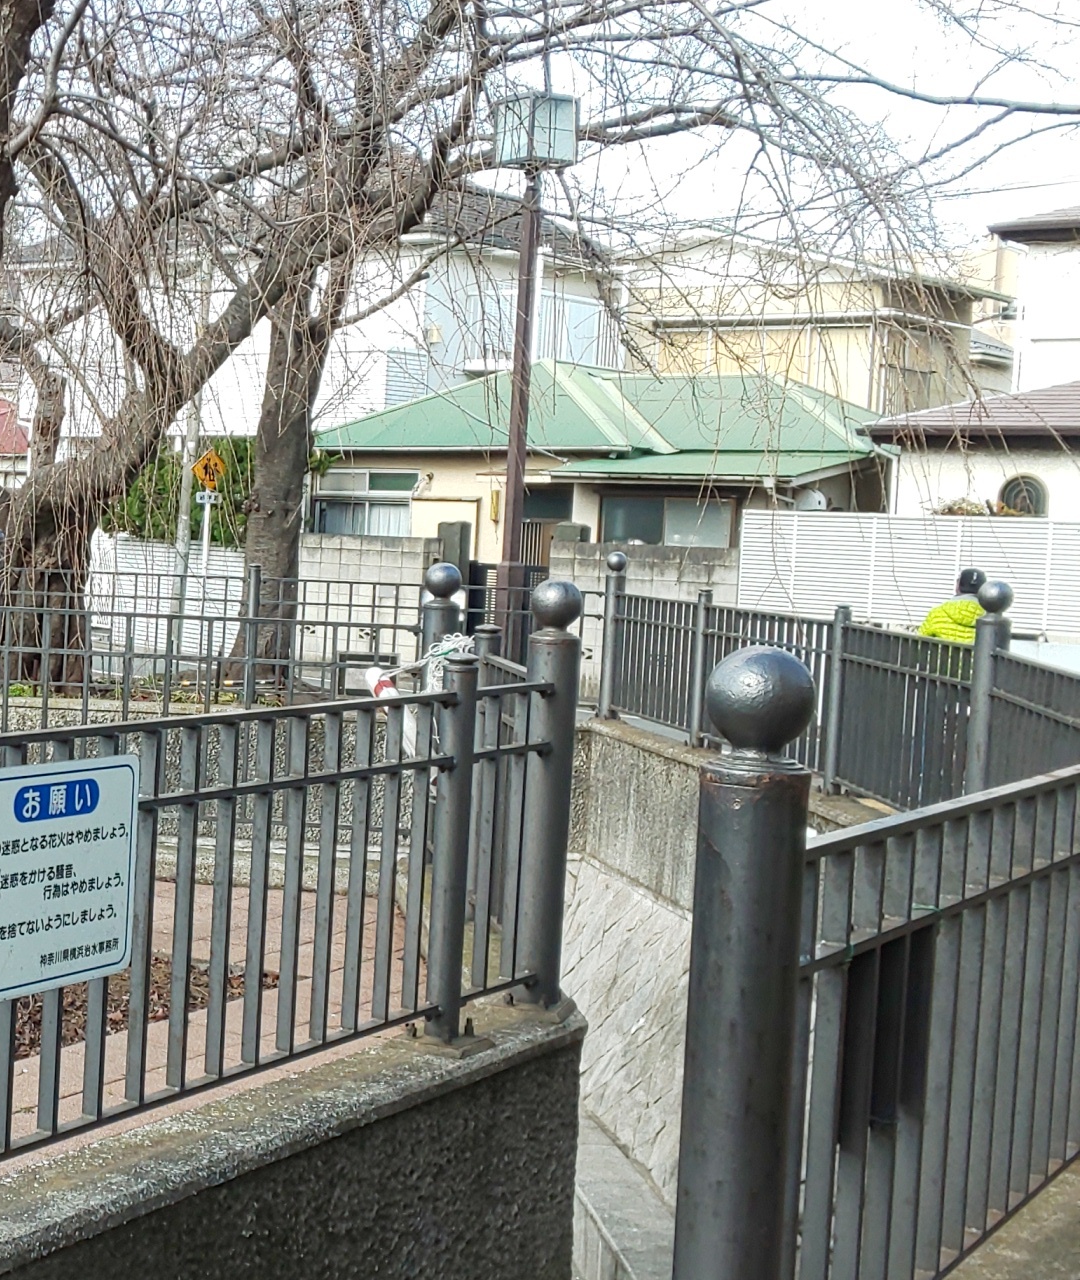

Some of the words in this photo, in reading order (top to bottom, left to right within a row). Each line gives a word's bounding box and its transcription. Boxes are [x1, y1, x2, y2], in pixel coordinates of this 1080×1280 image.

[21, 784, 92, 819] お願い
[43, 872, 125, 901] 行為はやめましょう。
[39, 937, 120, 967] 神奈川県横浜治水事務所
